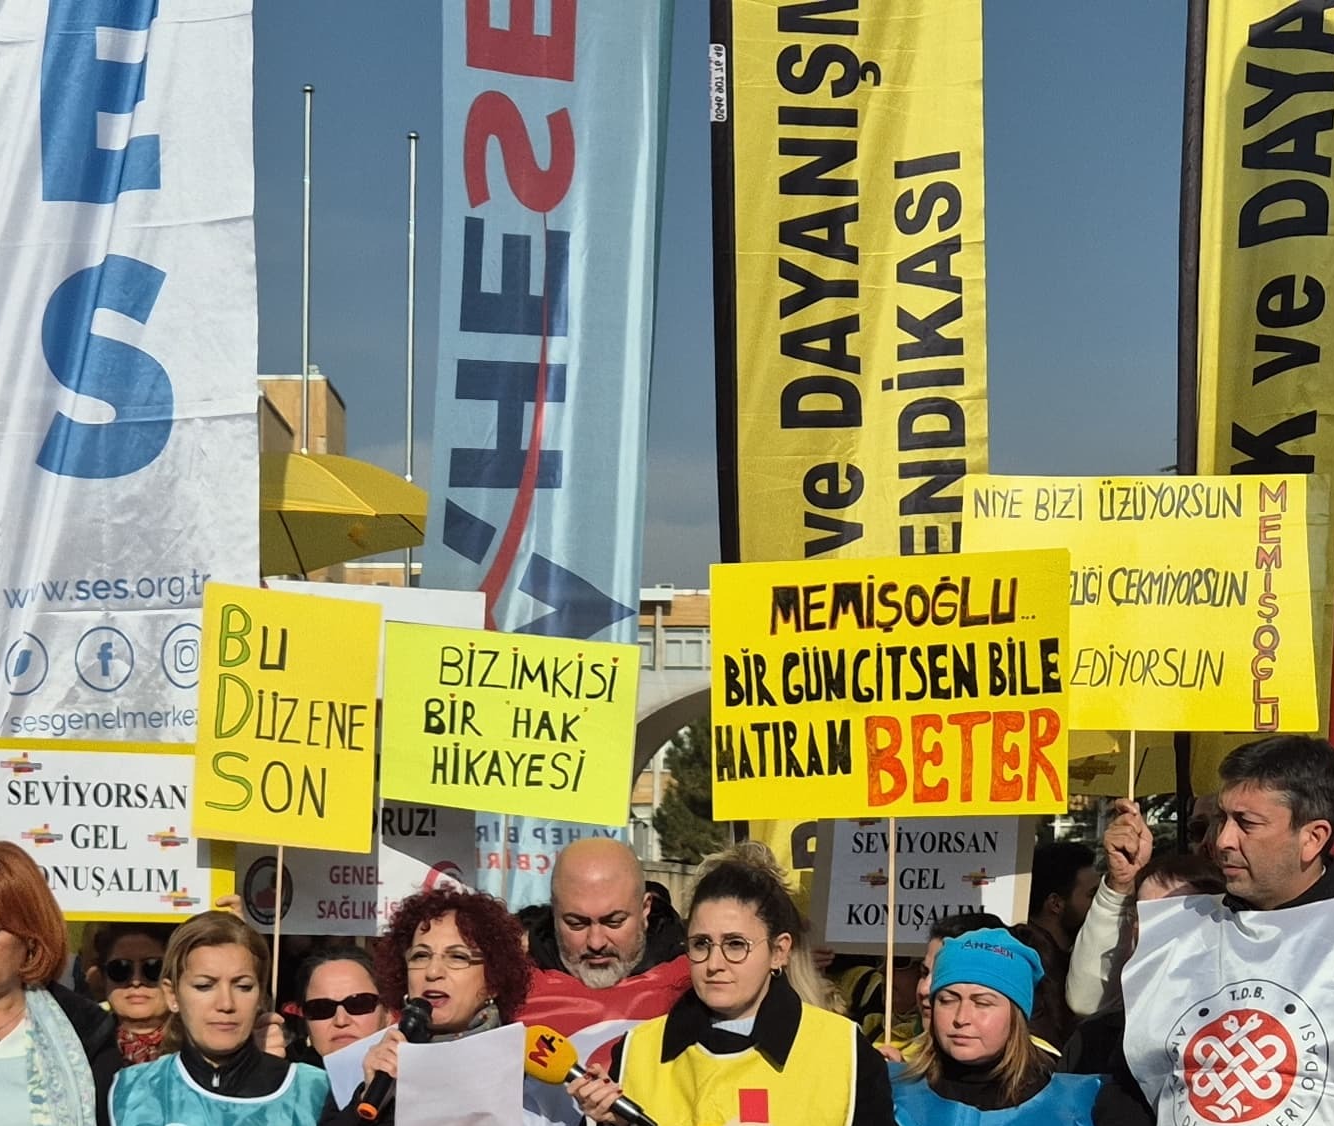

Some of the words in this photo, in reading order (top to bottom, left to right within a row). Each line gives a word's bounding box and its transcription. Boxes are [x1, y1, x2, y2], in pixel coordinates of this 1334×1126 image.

[1252, 274, 1326, 384] ve
[973, 484, 1024, 520] NİYE
[1034, 483, 1083, 522] BİZİ
[1098, 480, 1243, 522] ÜZÜYORSUN
[1108, 565, 1248, 608] ÇEKMİYORSUN
[219, 603, 288, 671] BU
[439, 641, 620, 703] BİZİMKİSİ
[724, 647, 777, 707] BİR
[782, 646, 846, 704] GÜN
[852, 639, 980, 703] GİTSEN
[988, 636, 1063, 697] BİLE
[1070, 643, 1226, 692] EDİYORSUN
[215, 673, 368, 751] DÜZENE
[424, 693, 483, 738] BİR
[430, 742, 587, 793] HİKAYESİ
[864, 707, 1064, 808] BETER
[7, 775, 188, 810] SEVİYORSAN
[205, 751, 327, 818] SON
[70, 823, 128, 850] GEL
[852, 826, 999, 854] SEVİYORSAN
[329, 865, 384, 886] GENEL
[899, 868, 945, 890] GEL
[1229, 987, 1265, 1001] T.D.B.
[1300, 1023, 1319, 1090] ODASI
